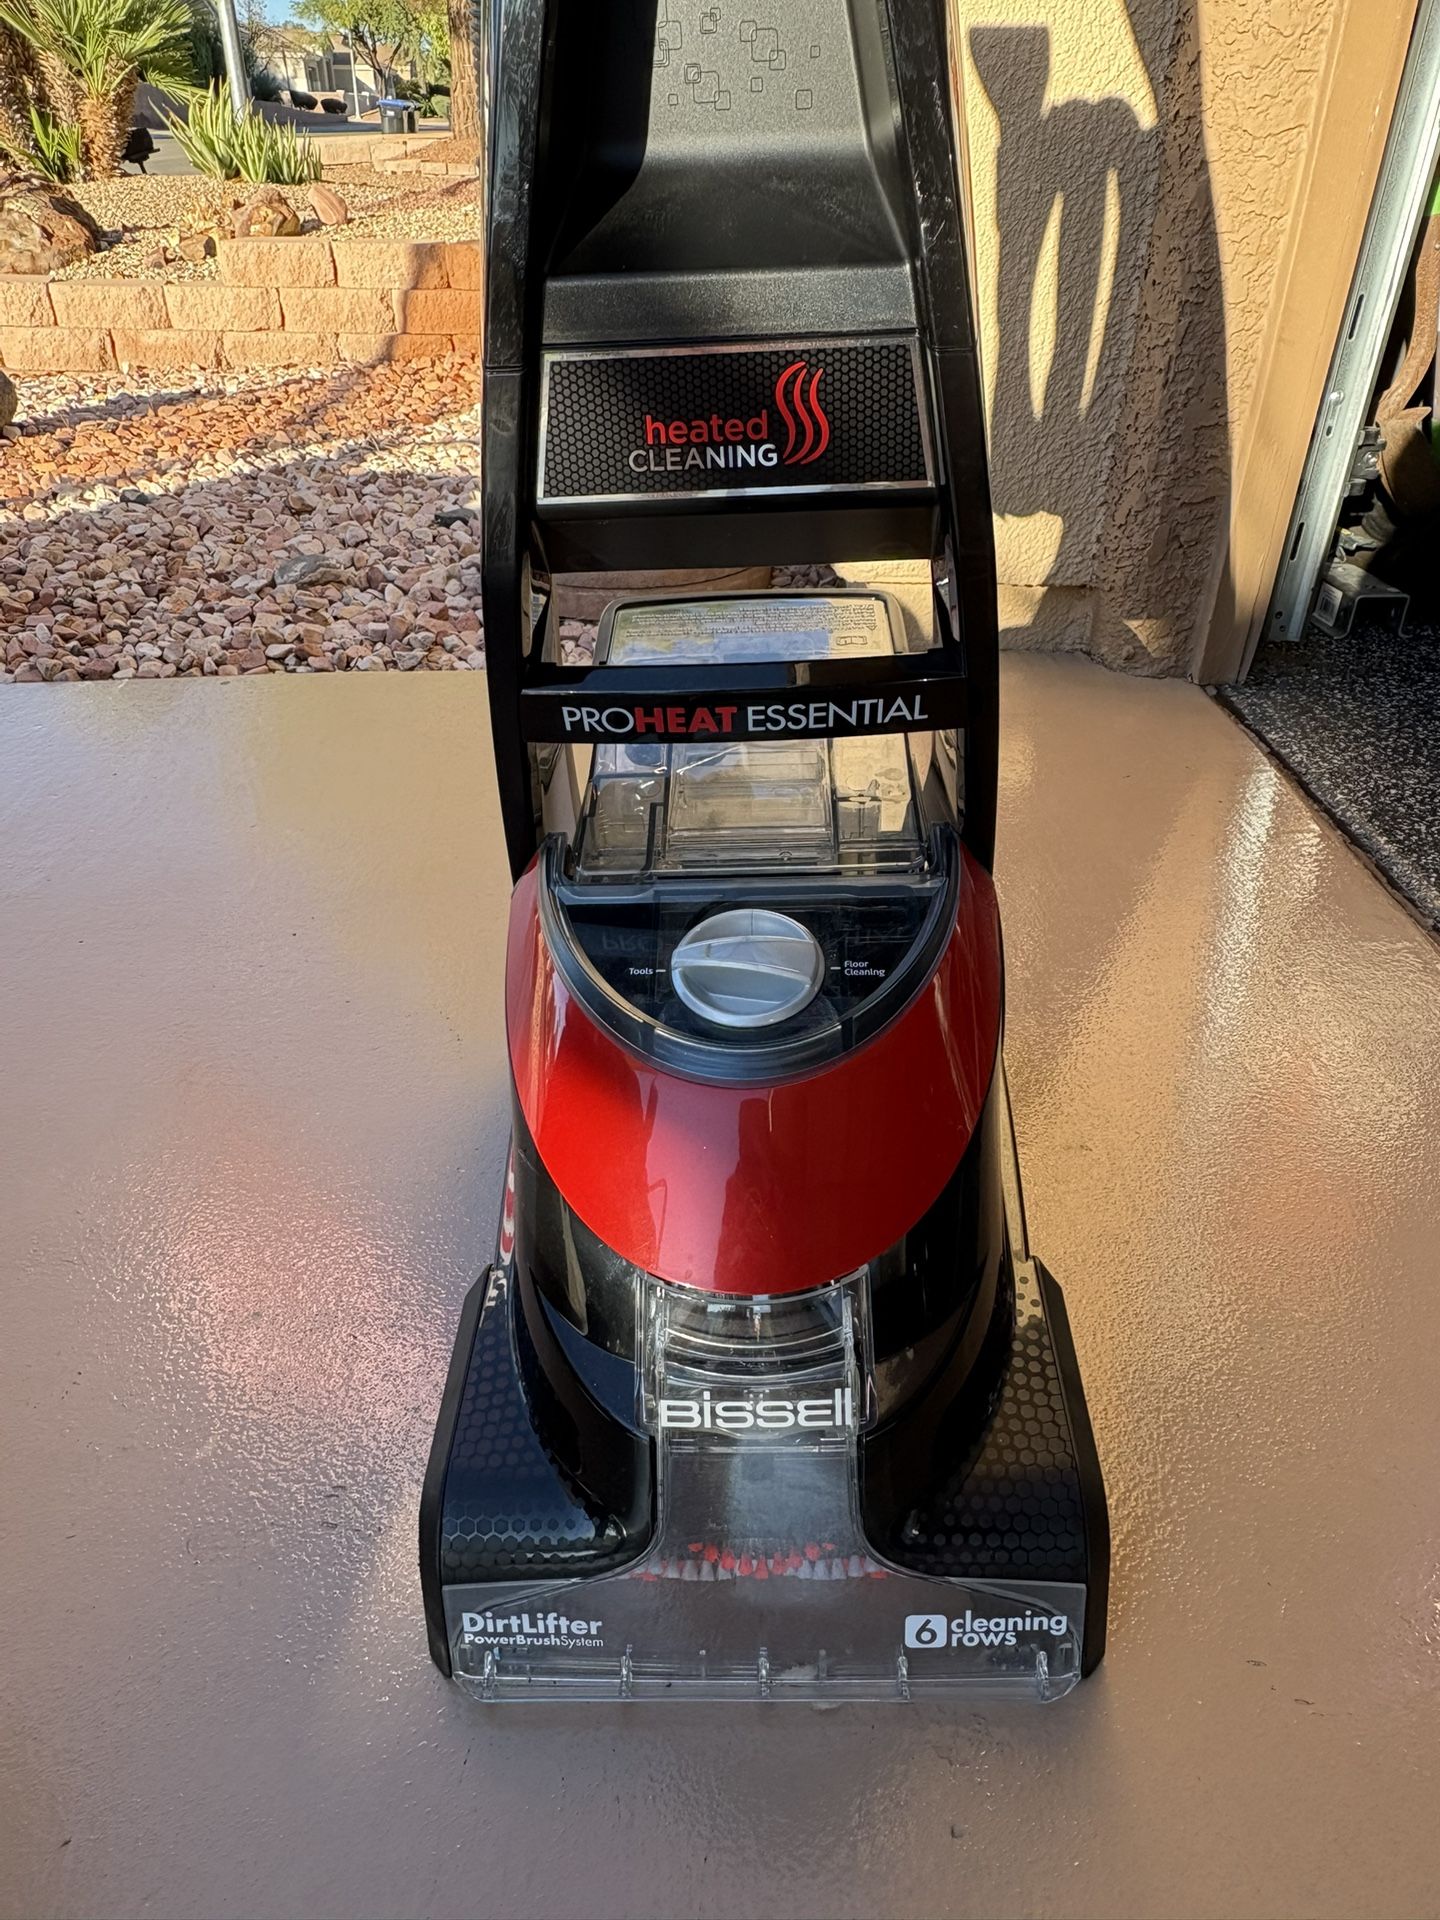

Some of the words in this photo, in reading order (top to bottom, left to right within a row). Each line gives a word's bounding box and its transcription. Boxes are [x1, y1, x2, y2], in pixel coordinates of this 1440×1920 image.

[645, 409, 768, 446] heated
[628, 443, 778, 473] CLEANING
[561, 705, 738, 734] PROHEAT
[747, 695, 929, 732] ESSENTIAL
[629, 966, 654, 976] Tools
[844, 960, 869, 968] Floor
[844, 968, 886, 977] Cleaning
[461, 1611, 603, 1635] DirtLifter
[915, 1618, 938, 1645] 6
[950, 1610, 1068, 1636] cleaning
[950, 1632, 1017, 1647] rows
